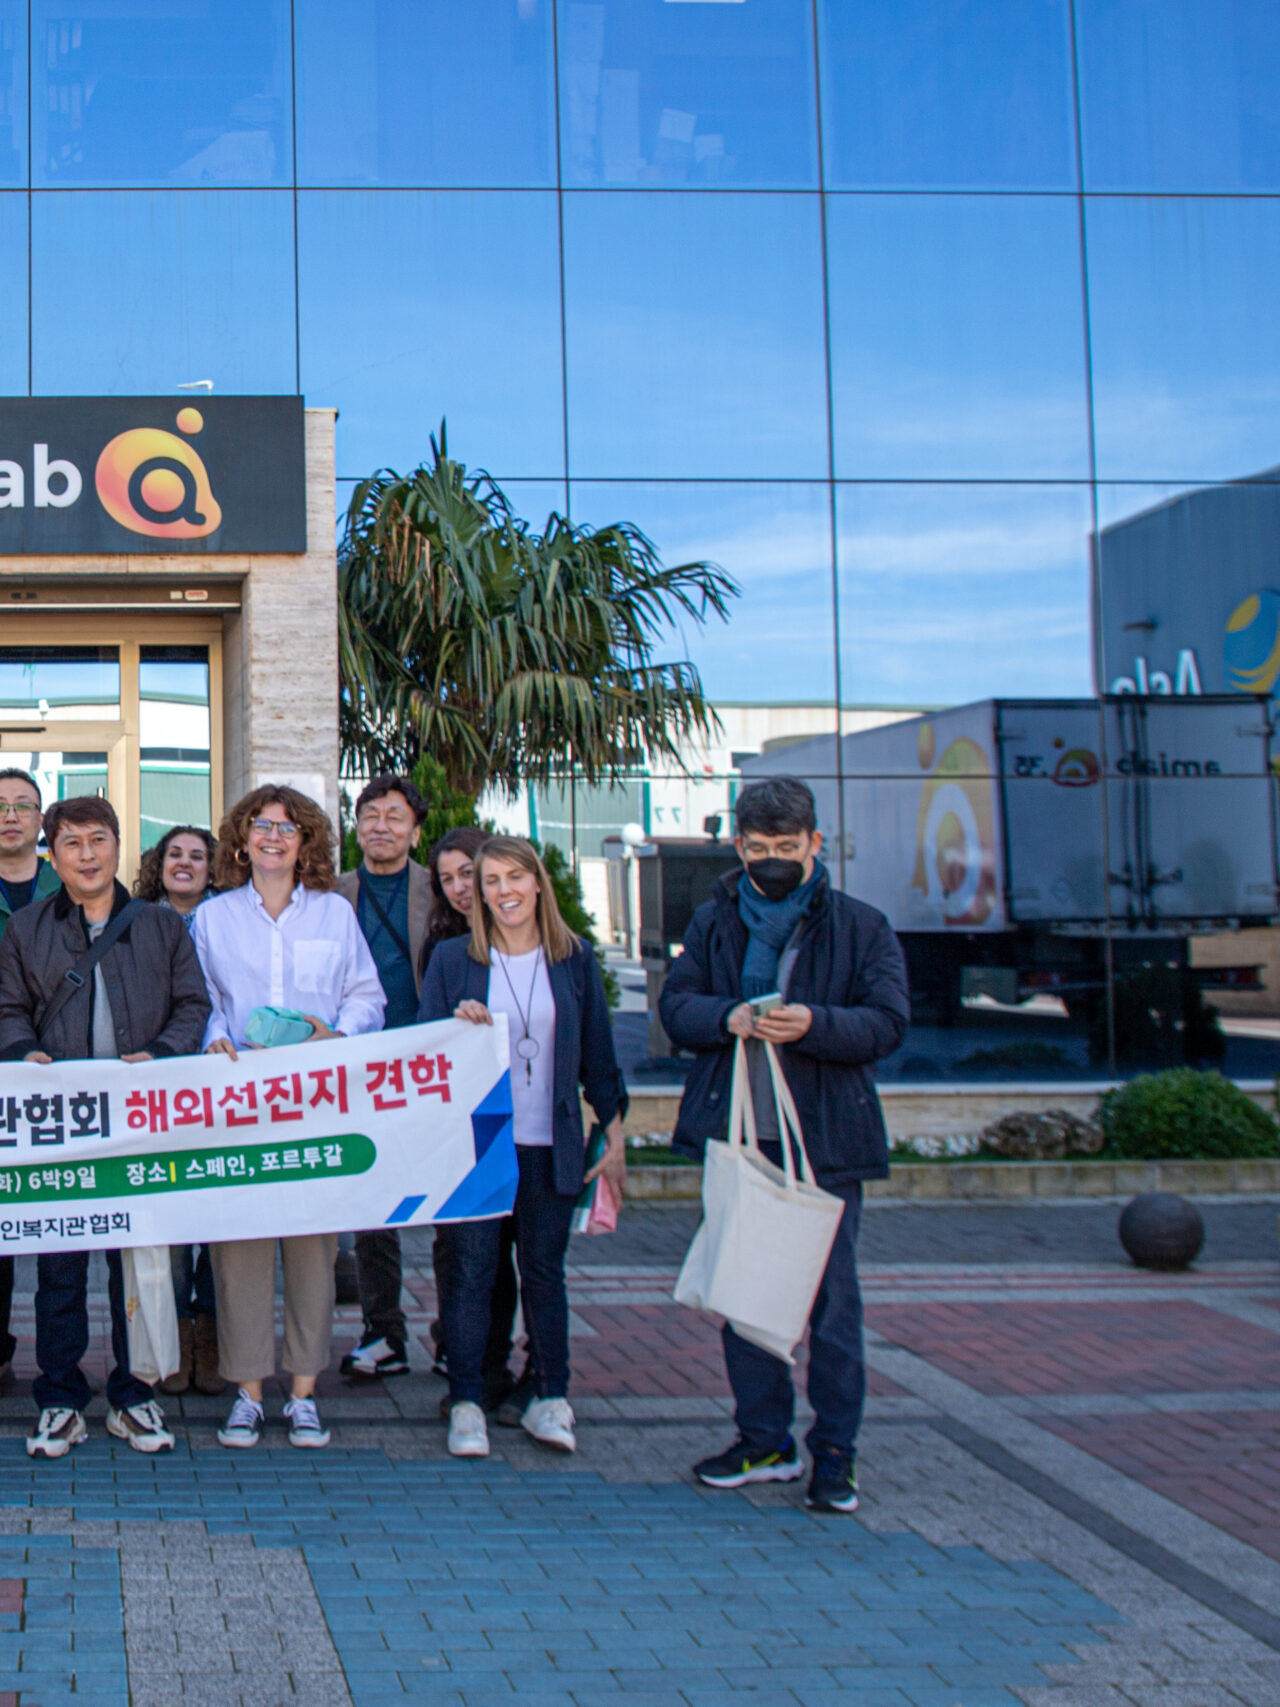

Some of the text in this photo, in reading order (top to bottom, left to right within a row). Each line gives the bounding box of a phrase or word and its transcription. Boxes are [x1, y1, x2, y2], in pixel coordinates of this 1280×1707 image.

[126, 1066, 349, 1132] 해외선진지
[366, 1054, 452, 1110] 견학
[28, 1165, 96, 1190] 6박9일
[127, 1162, 167, 1186] 장소
[185, 1155, 255, 1178] 스페인,
[261, 1144, 343, 1171] 포르투갈
